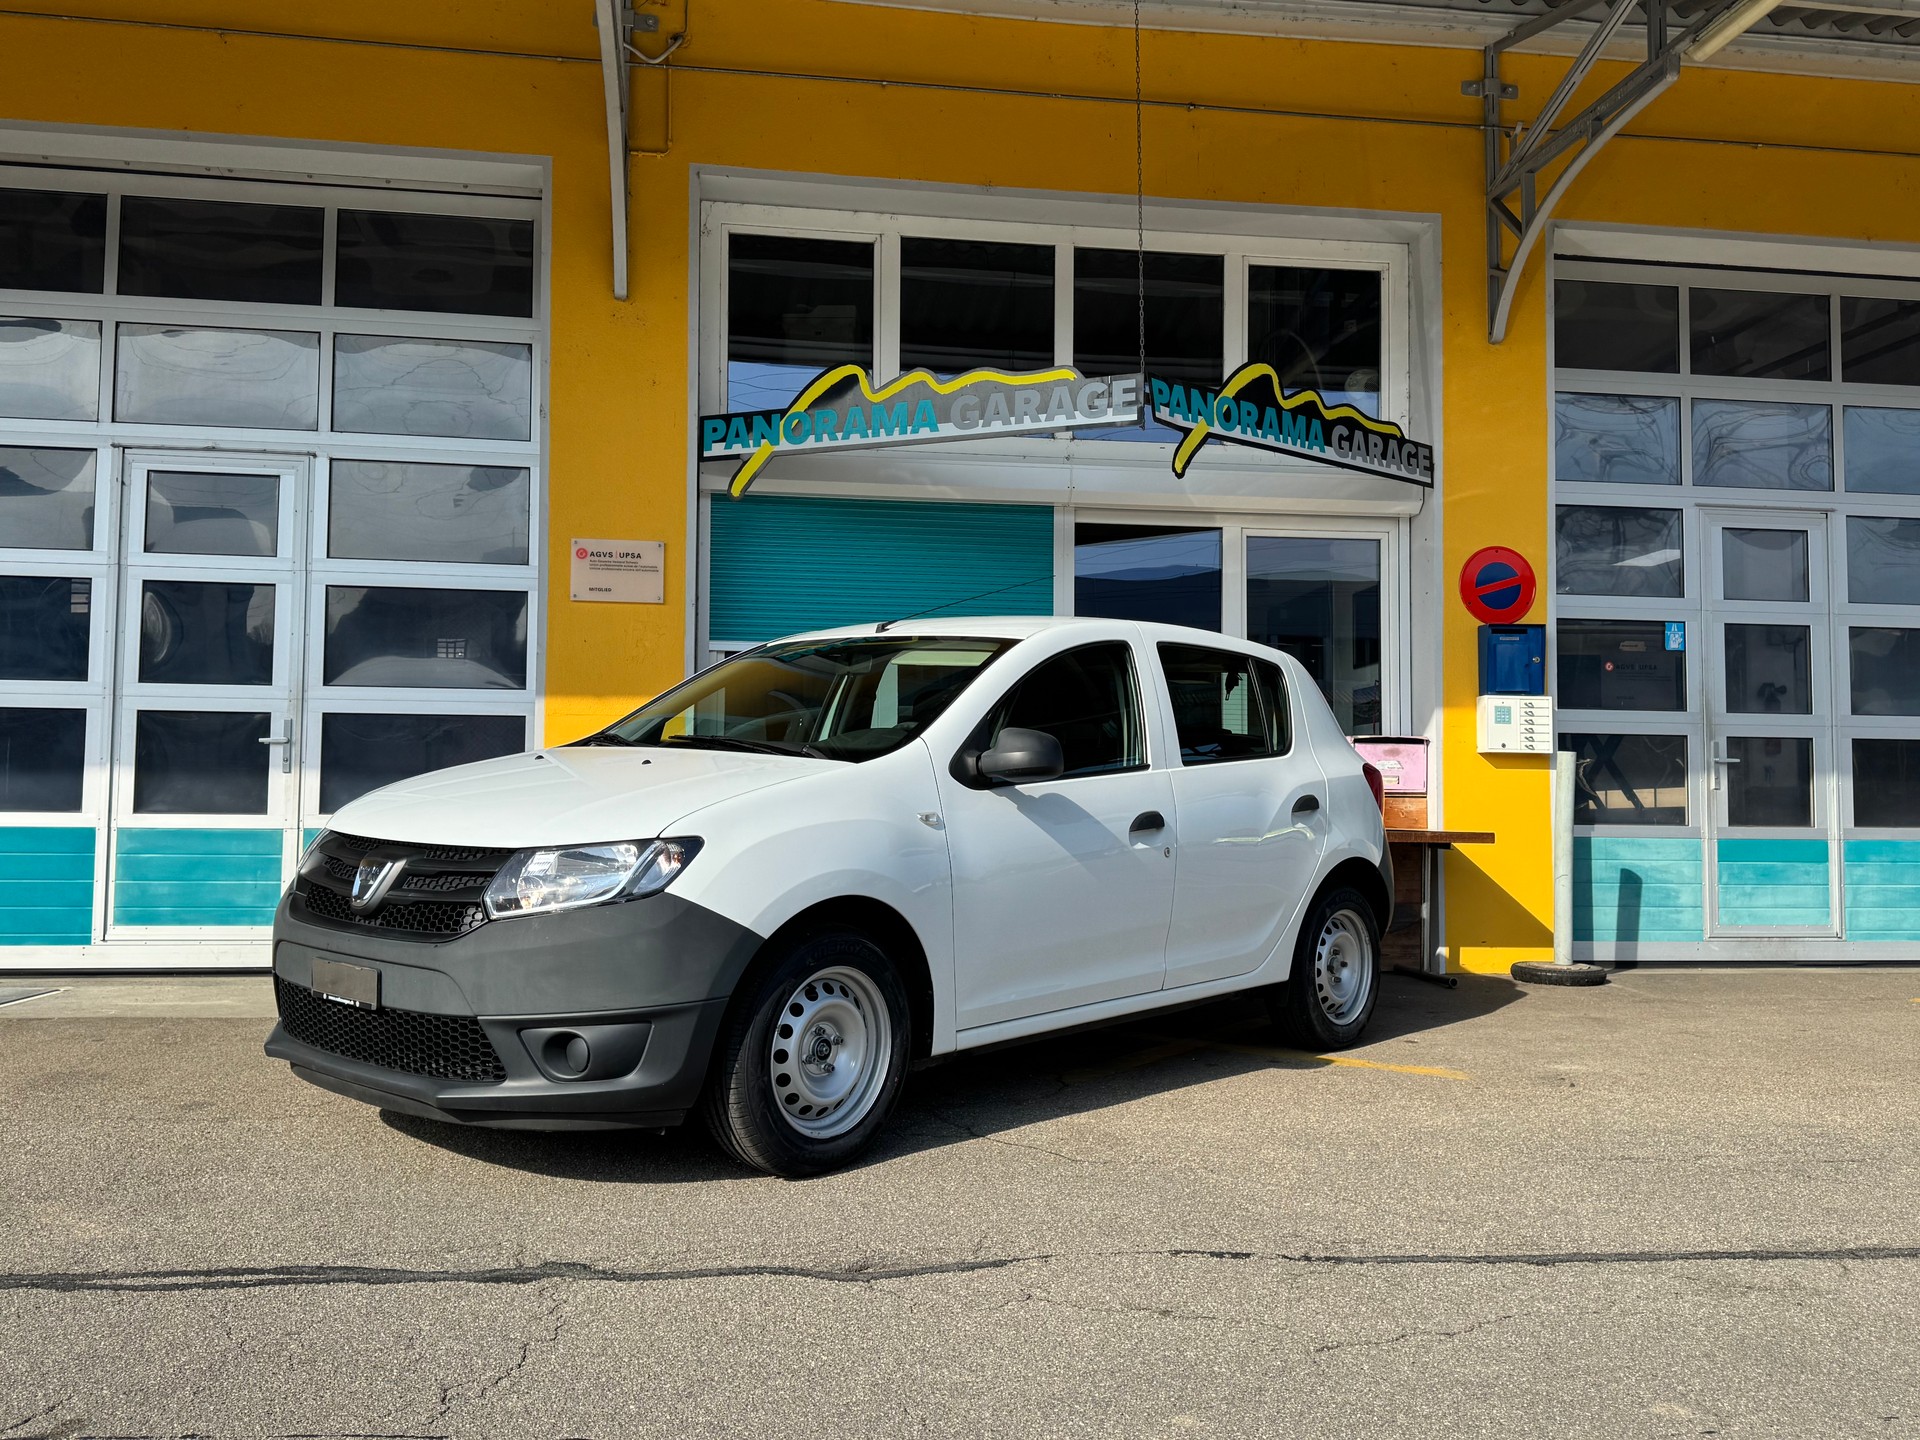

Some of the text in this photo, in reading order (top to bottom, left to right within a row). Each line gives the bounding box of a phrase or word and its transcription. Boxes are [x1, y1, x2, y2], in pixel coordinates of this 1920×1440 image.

[703, 379, 1139, 452] PANORAMA GARAGE
[1151, 377, 1433, 478] PANORAMA GARAGE
